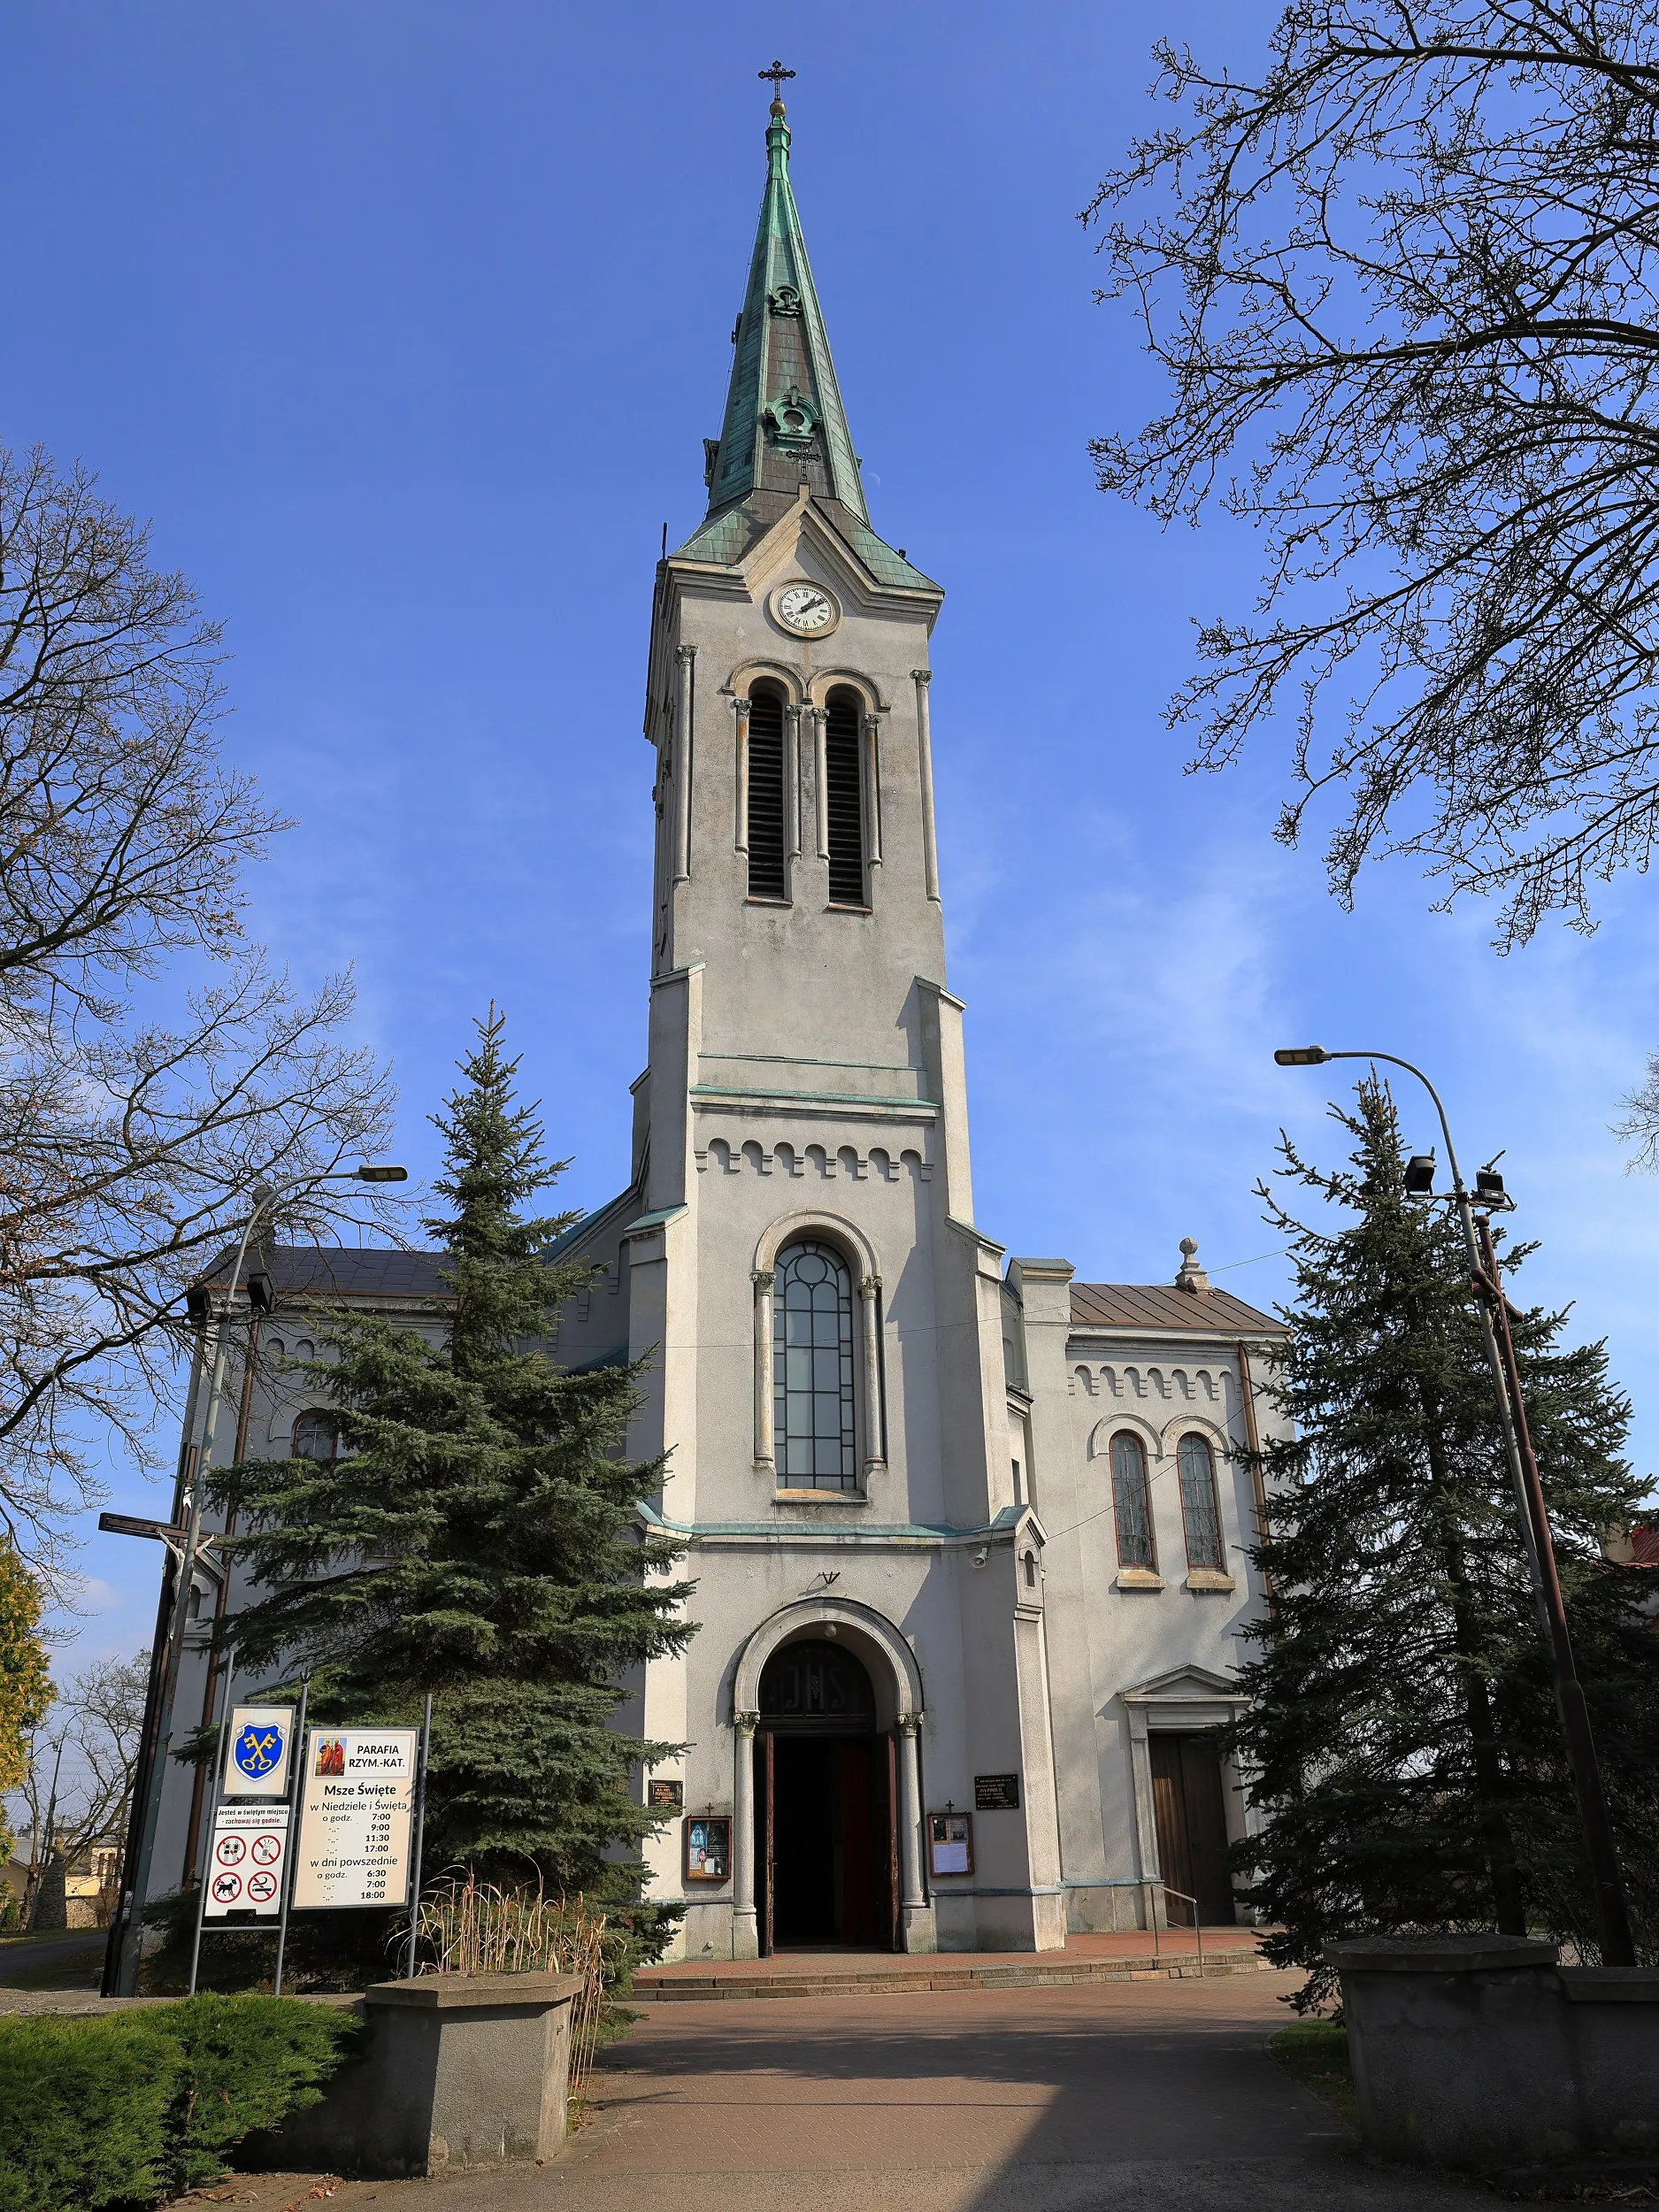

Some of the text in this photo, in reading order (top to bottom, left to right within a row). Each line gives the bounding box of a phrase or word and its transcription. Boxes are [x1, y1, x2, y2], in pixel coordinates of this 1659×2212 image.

[357, 1745, 399, 1755] PARAFIA
[349, 1758, 405, 1768] RZYM.-KAT.
[324, 1782, 396, 1796] Msze Święte
[321, 1801, 366, 1811] Niedziele
[374, 1800, 407, 1810] Święta
[330, 1814, 352, 1824] godz.
[321, 1856, 337, 1867] dni
[340, 1856, 397, 1869] powszednie
[325, 1871, 347, 1880] godz.
